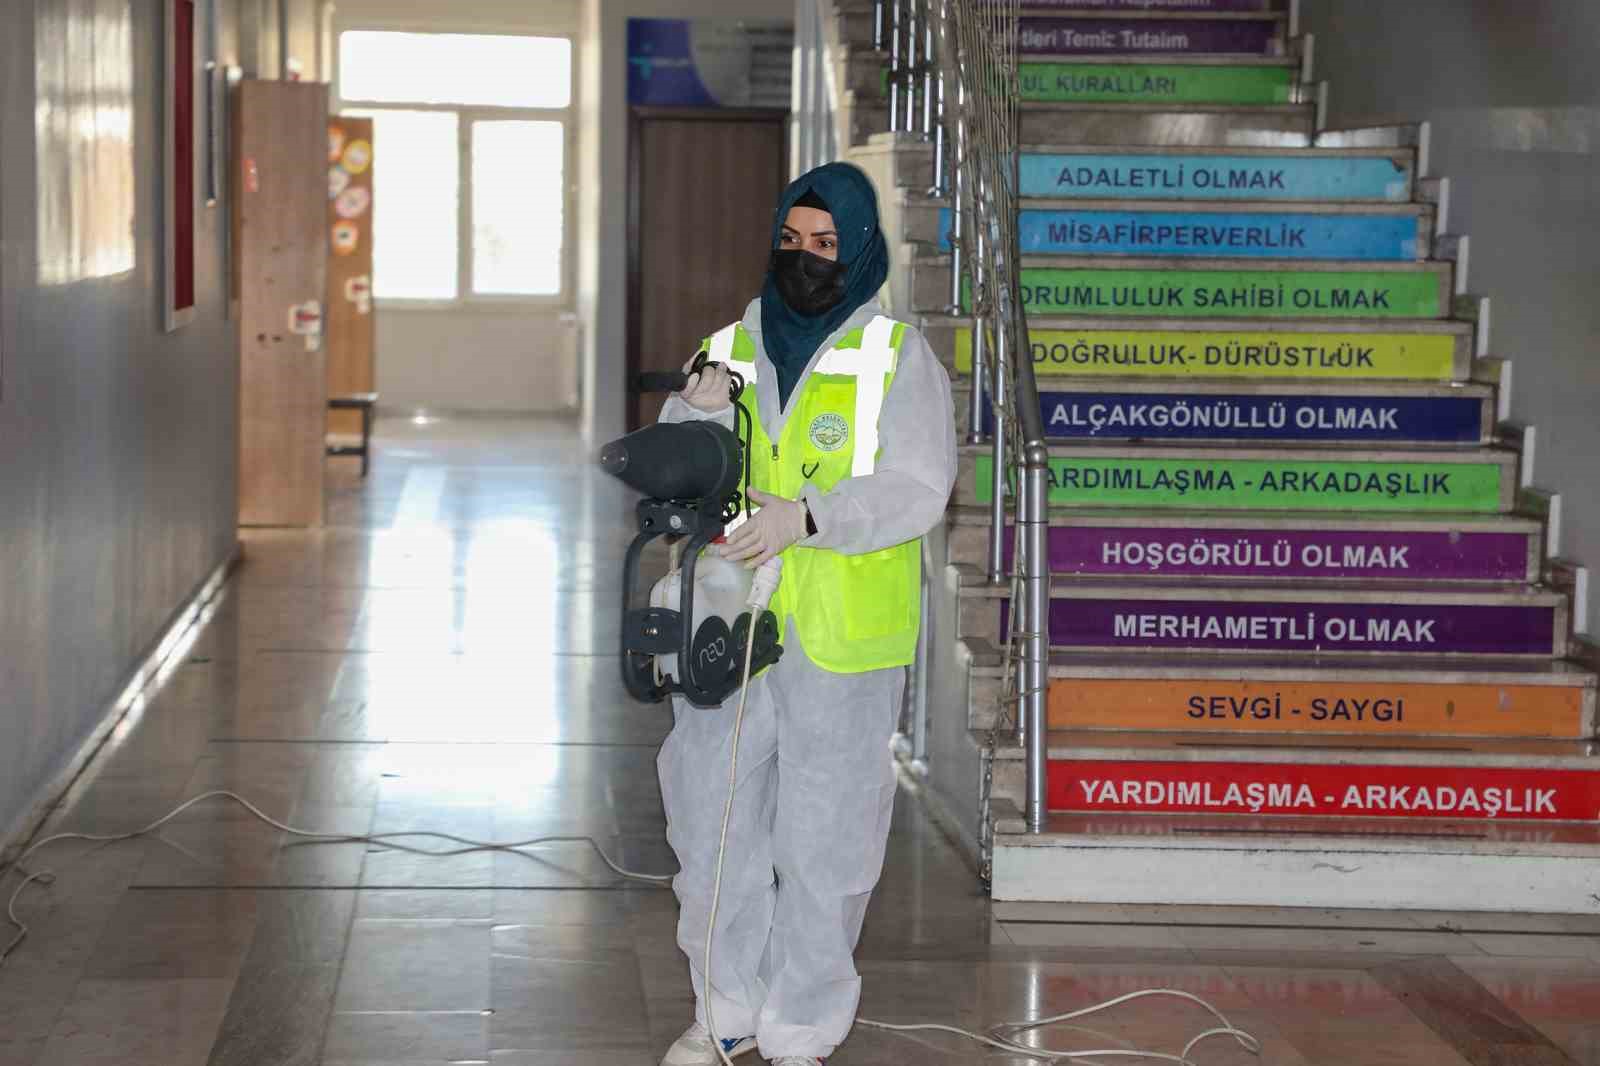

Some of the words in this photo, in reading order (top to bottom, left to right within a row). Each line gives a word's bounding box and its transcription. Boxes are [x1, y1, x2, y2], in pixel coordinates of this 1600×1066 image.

[1062, 29, 1116, 48] Temiz
[1120, 30, 1188, 49] Tutalım
[1022, 76, 1049, 92] UL
[1056, 76, 1176, 96] KURALLARI
[1057, 163, 1184, 188] ADALETLİ
[1193, 168, 1285, 190] OLMAK
[1048, 219, 1306, 248] MİSAFİRPERVERLİK
[1021, 285, 1184, 307] ORUMLULUK
[1193, 283, 1284, 308] SAHİBİ
[1293, 288, 1390, 310] OLMAK
[1204, 341, 1375, 367] DÜRÜSTLÜK
[1050, 401, 1286, 435] ALÇAKGÖNÜLLÜ
[1295, 406, 1399, 430] OLMAK
[1047, 467, 1235, 493] ARDIMLAŞMA
[1259, 471, 1452, 498] ARKADAŞLIK
[1102, 538, 1292, 568] HOŞGÖRÜLÜ
[1301, 545, 1410, 569] OLMAK
[1113, 612, 1315, 641] MERHAMETLİ
[1324, 618, 1436, 643] OLMAK
[1187, 692, 1282, 720] SEVGİ
[1310, 699, 1404, 722] SAYGI
[1079, 779, 1315, 812] YARDIMLAŞMA
[1341, 785, 1557, 815] ARKADAŞLIK
